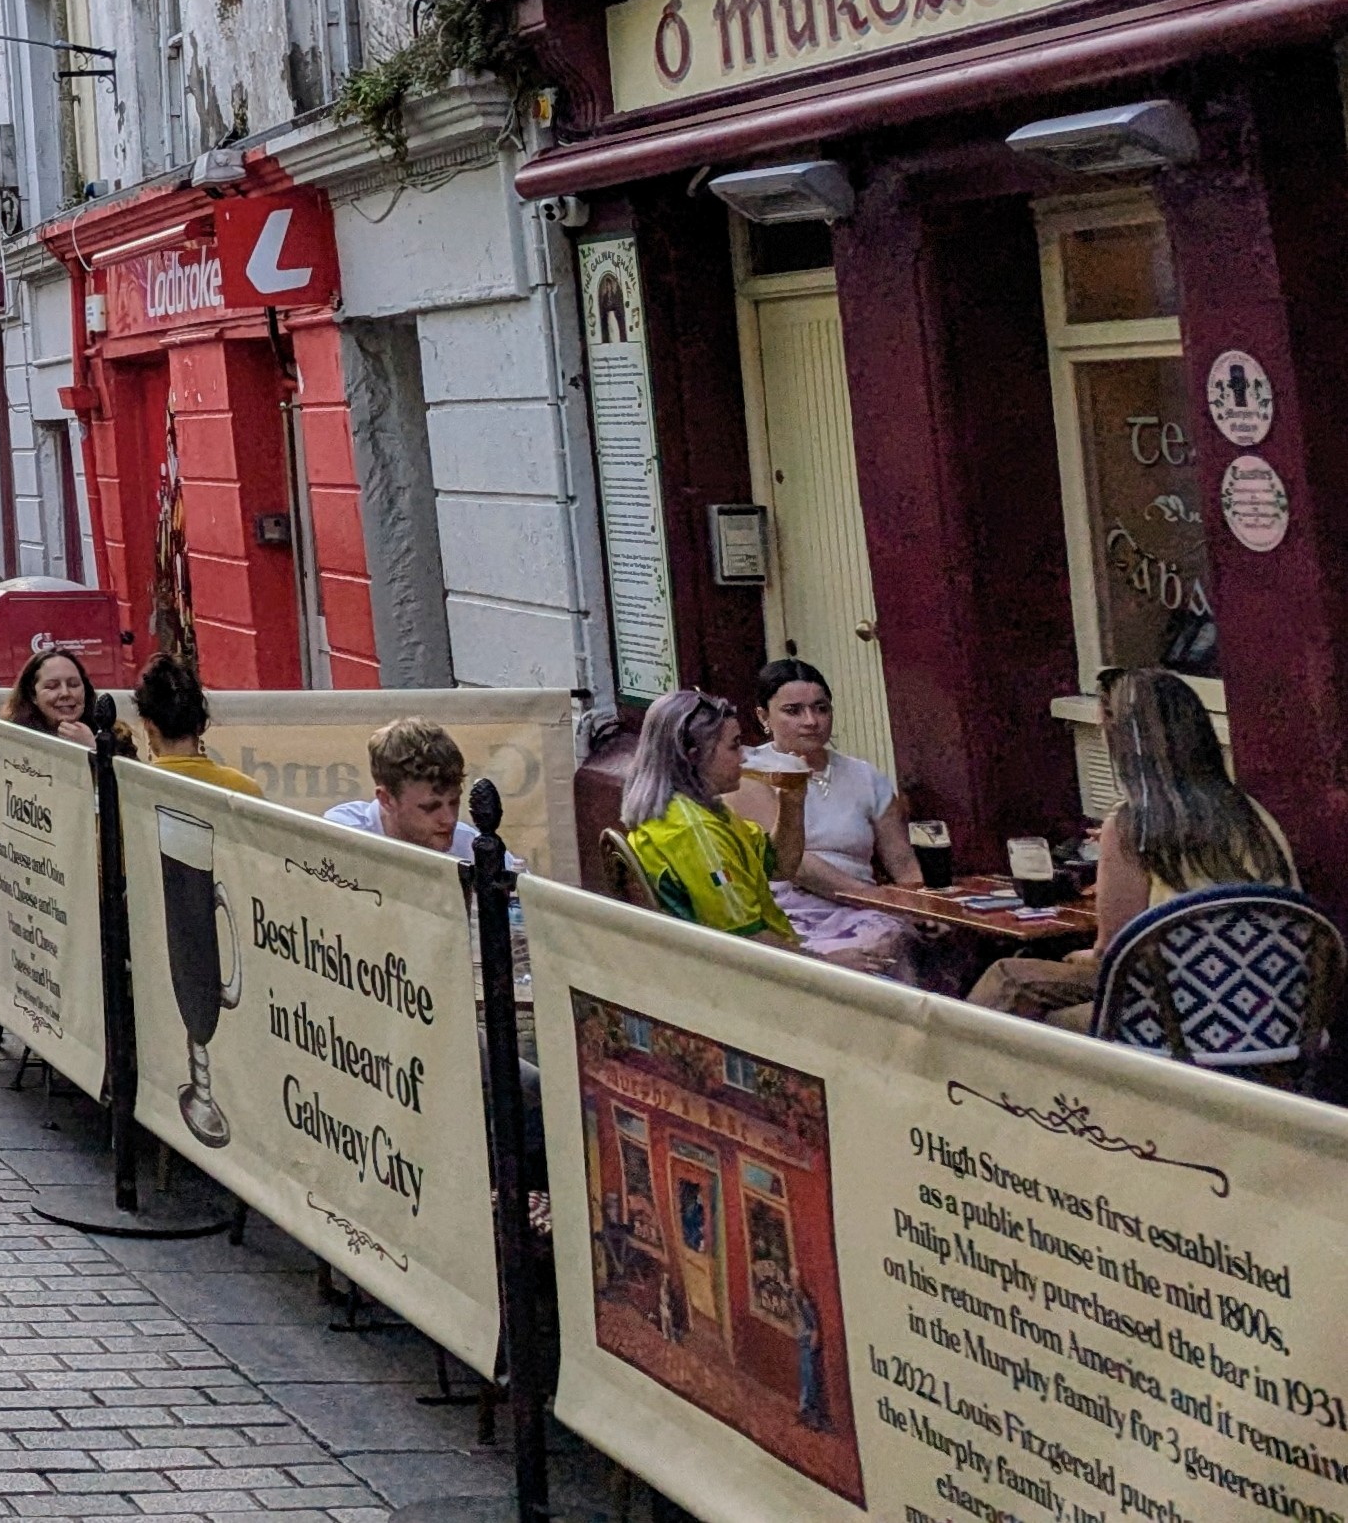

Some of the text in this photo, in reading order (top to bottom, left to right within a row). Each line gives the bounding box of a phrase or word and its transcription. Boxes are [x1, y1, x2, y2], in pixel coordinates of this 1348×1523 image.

[146, 244, 224, 318] Ladbroke
[5, 779, 53, 833] Toasties
[252, 896, 434, 1026] Best Irish coffee
[269, 987, 425, 1115] in the heart of
[283, 1074, 424, 1217] Galway City
[910, 1126, 1292, 1298] 9 High Street was first established
[893, 1207, 952, 1267] Philip
[955, 1233, 1039, 1303] Murphy
[1043, 1282, 1164, 1352] purchased
[1168, 1327, 1207, 1371] the
[1209, 1343, 1251, 1388] bar
[1254, 1366, 1281, 1408] in
[919, 1183, 943, 1209] as
[946, 1192, 958, 1216] a
[961, 1196, 1024, 1242] public
[1028, 1218, 1094, 1271] house
[1097, 1247, 1122, 1283] in
[1123, 1259, 1162, 1299] the
[1165, 1282, 1214, 1321] mid
[883, 1256, 907, 1284] on
[908, 1259, 939, 1299] his
[941, 1281, 1007, 1331] return
[1009, 1307, 1064, 1357] from
[1170, 1386, 1213, 1429] and
[1215, 1400, 1235, 1440] it
[907, 1305, 928, 1338] in
[929, 1320, 962, 1356] the
[964, 1330, 1051, 1404] Murphy
[1054, 1374, 1127, 1441] family
[1129, 1409, 1165, 1454] for
[1166, 1428, 1182, 1465] 3
[868, 1344, 890, 1381] In
[944, 1380, 1005, 1438] Louis
[1004, 1409, 1116, 1497] Fitzgerald
[877, 1397, 908, 1434] the
[908, 1408, 993, 1481] Murphy
